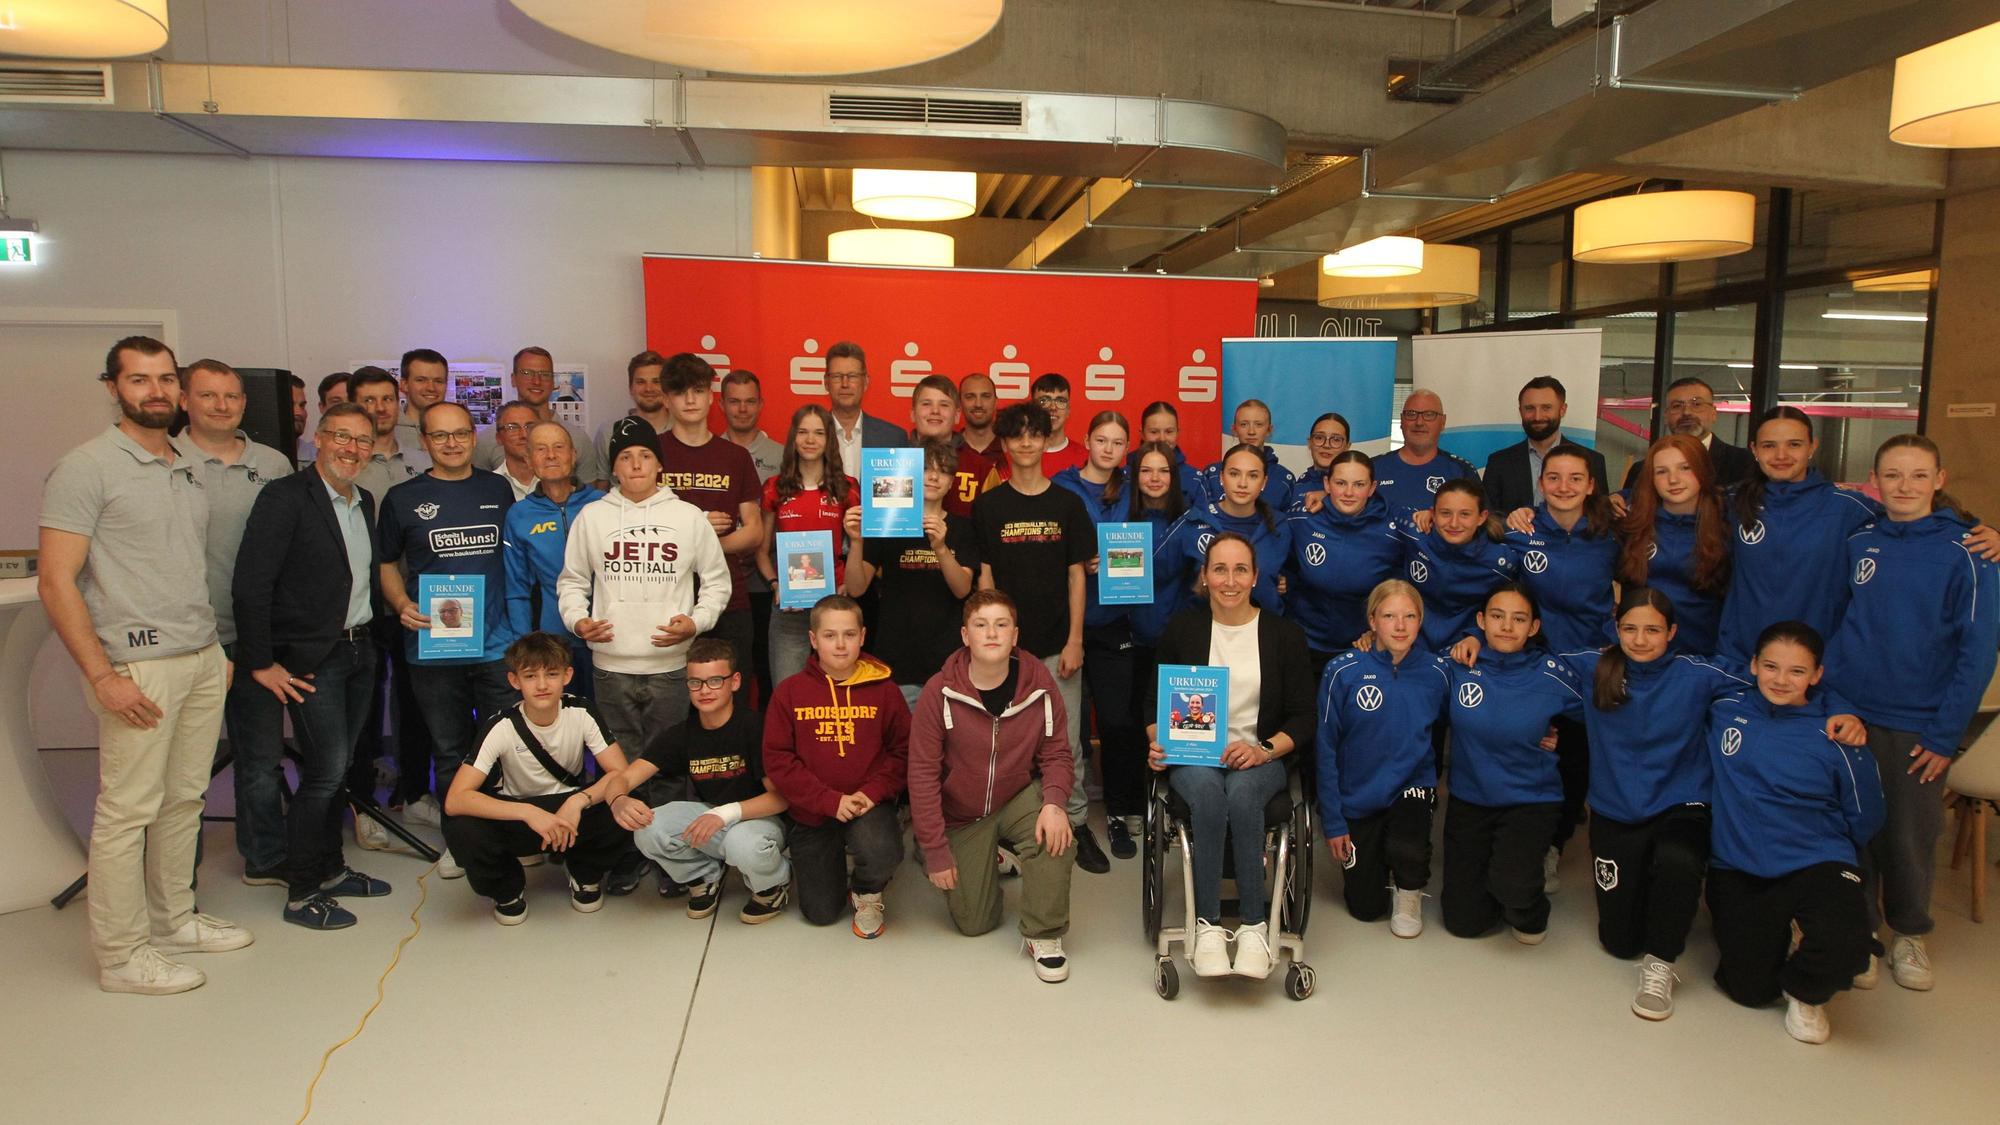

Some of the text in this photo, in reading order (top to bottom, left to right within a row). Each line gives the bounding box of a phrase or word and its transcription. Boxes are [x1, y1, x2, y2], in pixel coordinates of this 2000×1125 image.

[657, 472, 730, 489] JETS 2024
[1000, 528, 1042, 537] CHAMPIONS
[1106, 532, 1144, 540] URKUNDE
[435, 532, 495, 547] baukunst
[604, 541, 678, 562] JETS
[900, 555, 939, 563] CHAMPION
[604, 561, 676, 574] FOOTBALL
[429, 584, 475, 593] URKUNDE
[128, 629, 159, 648] ME
[1169, 676, 1219, 687] URKUNDE
[794, 705, 879, 720] TROISDORF
[815, 721, 855, 735] JETS
[729, 759, 746, 770] 204
